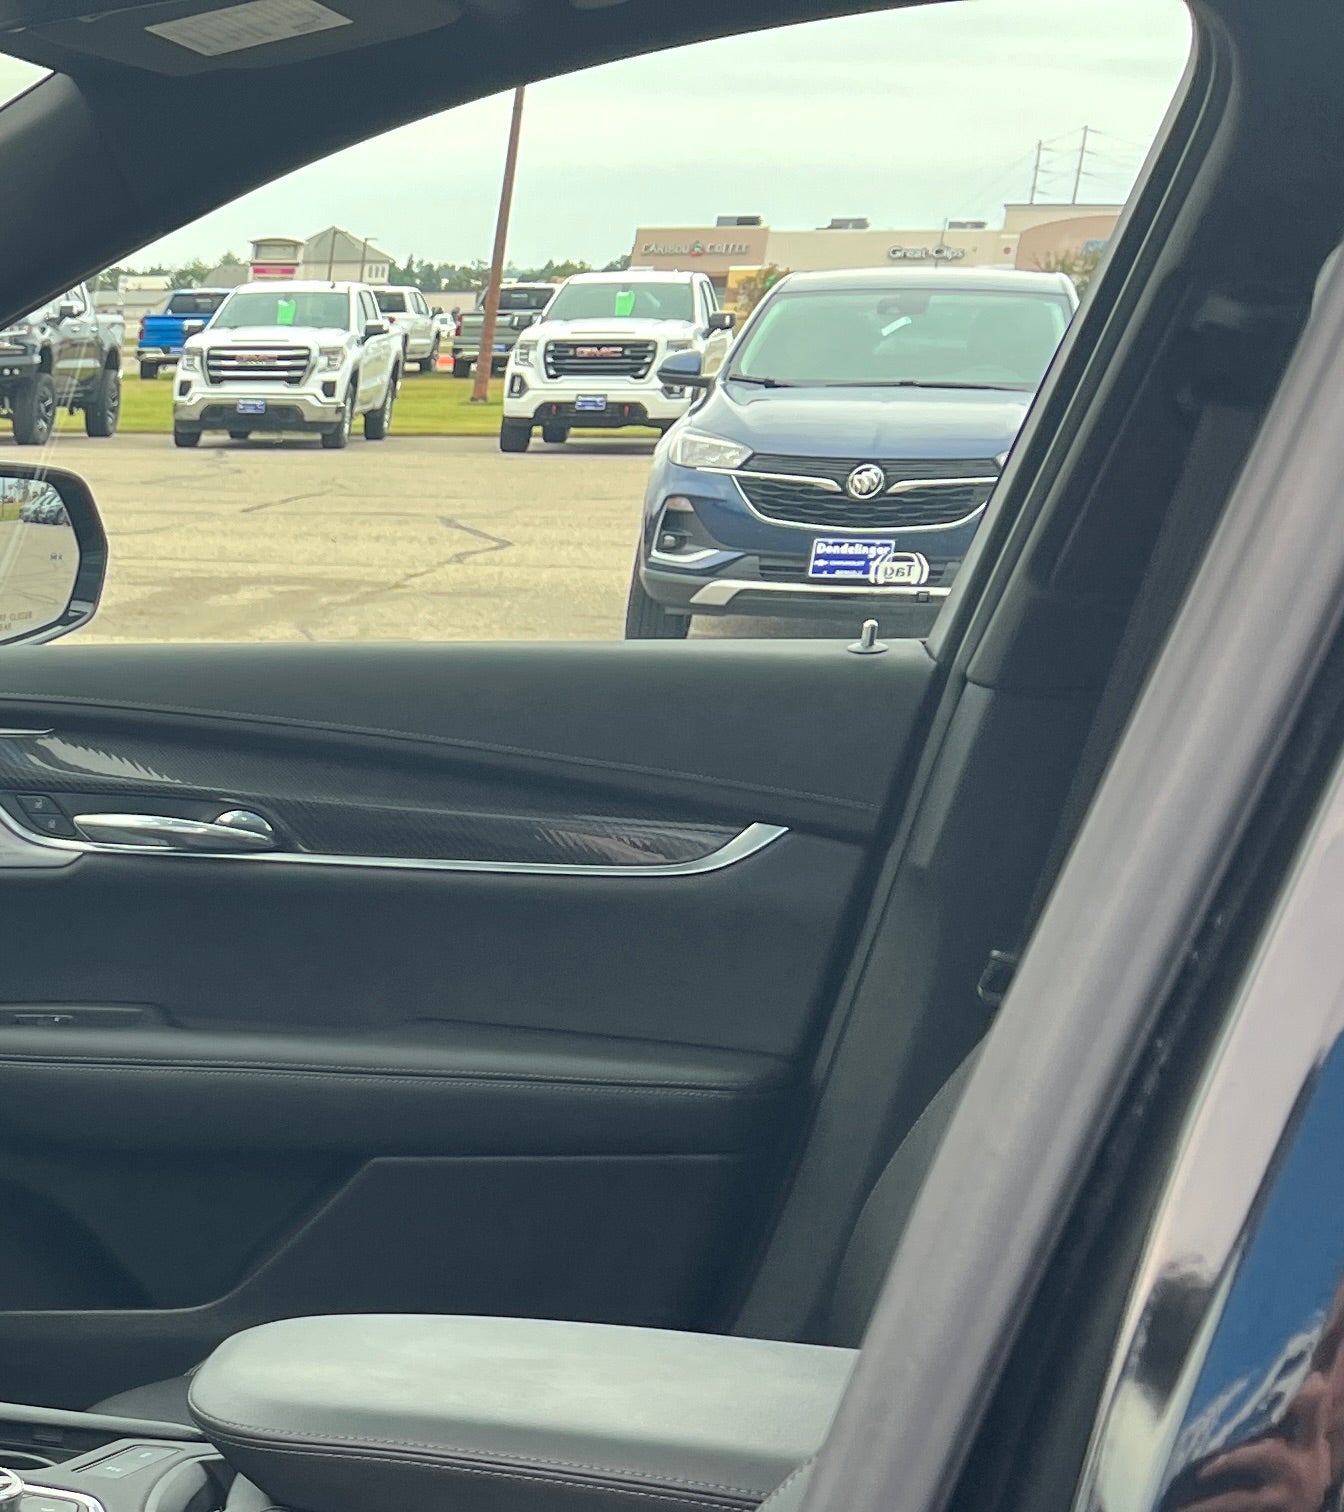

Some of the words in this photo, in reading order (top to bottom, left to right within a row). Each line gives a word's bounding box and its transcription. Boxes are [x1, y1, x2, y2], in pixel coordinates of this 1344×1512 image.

[641, 243, 690, 256] CARIBOU
[706, 242, 749, 254] COFFEE
[888, 246, 927, 260] Great
[816, 542, 891, 559] Dondelinger
